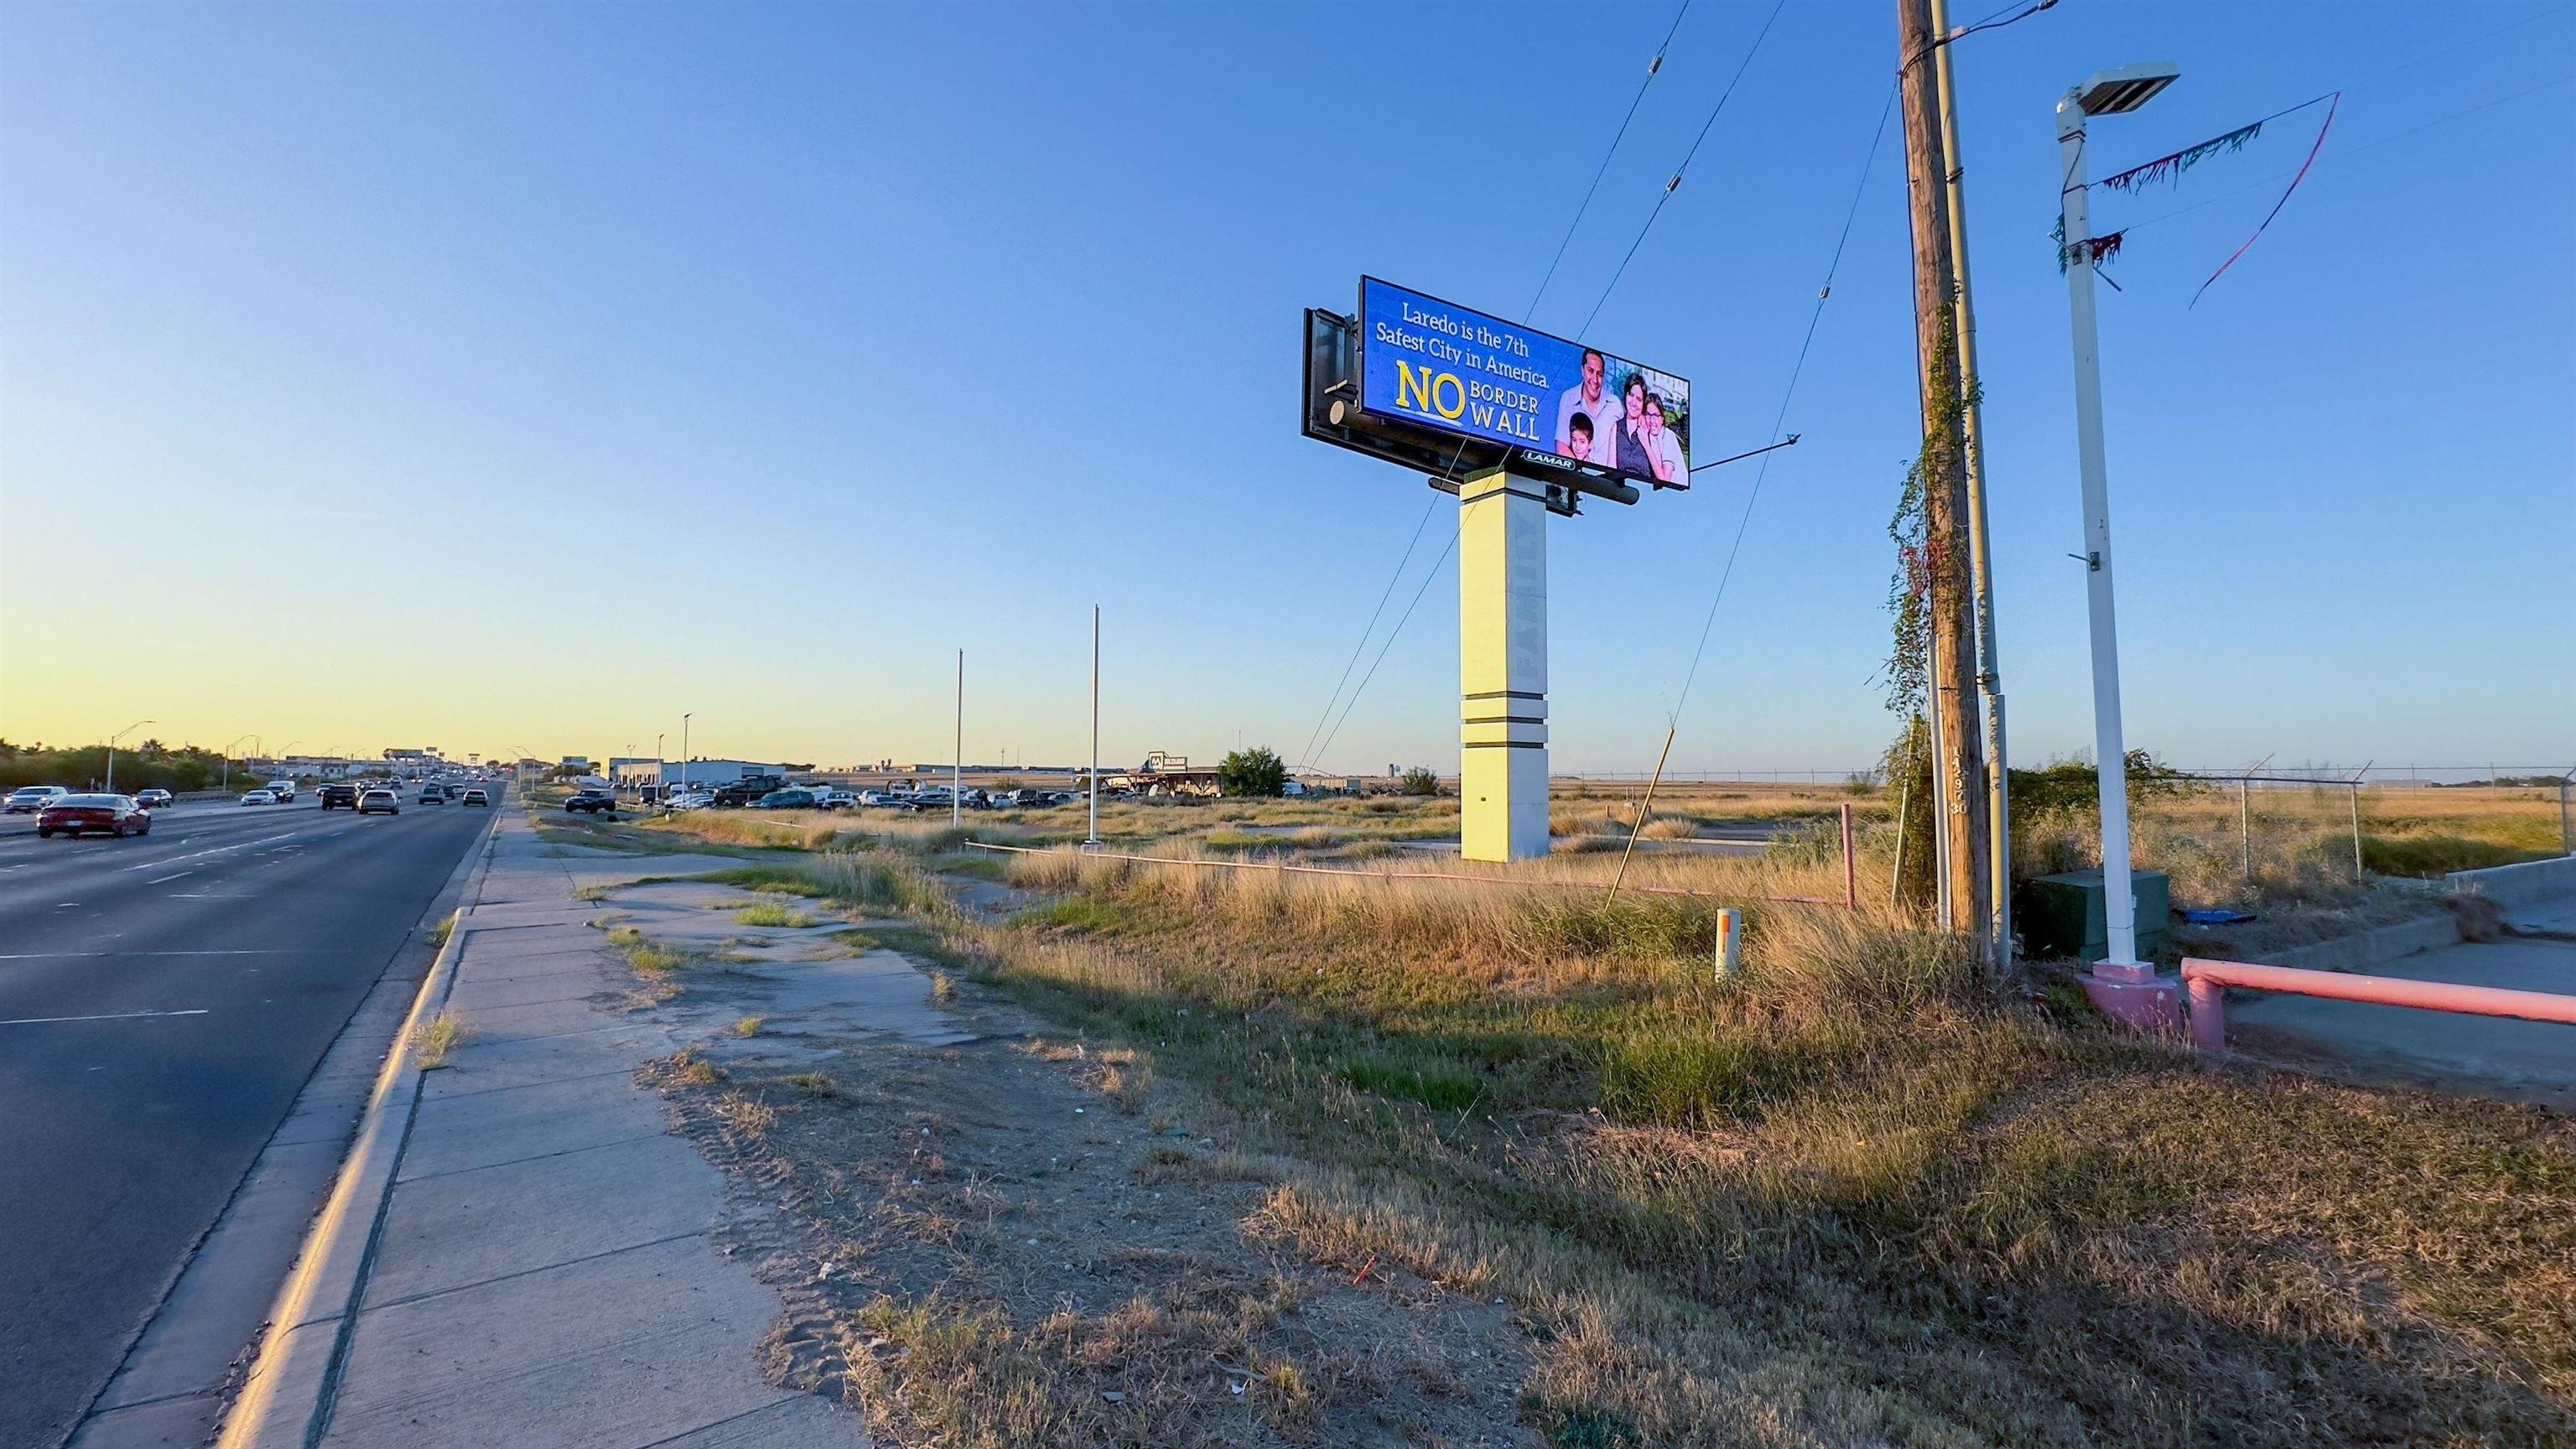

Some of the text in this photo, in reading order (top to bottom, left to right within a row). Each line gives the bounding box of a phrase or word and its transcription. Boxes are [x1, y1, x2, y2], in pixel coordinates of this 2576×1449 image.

[1402, 302, 1530, 358] Laredo is the 7th
[1376, 321, 1550, 389] Safest City in America.
[1395, 359, 1467, 420] NO
[1469, 380, 1540, 415] BORDER
[1469, 402, 1540, 442] WALL
[1525, 452, 1573, 469] LAMAR
